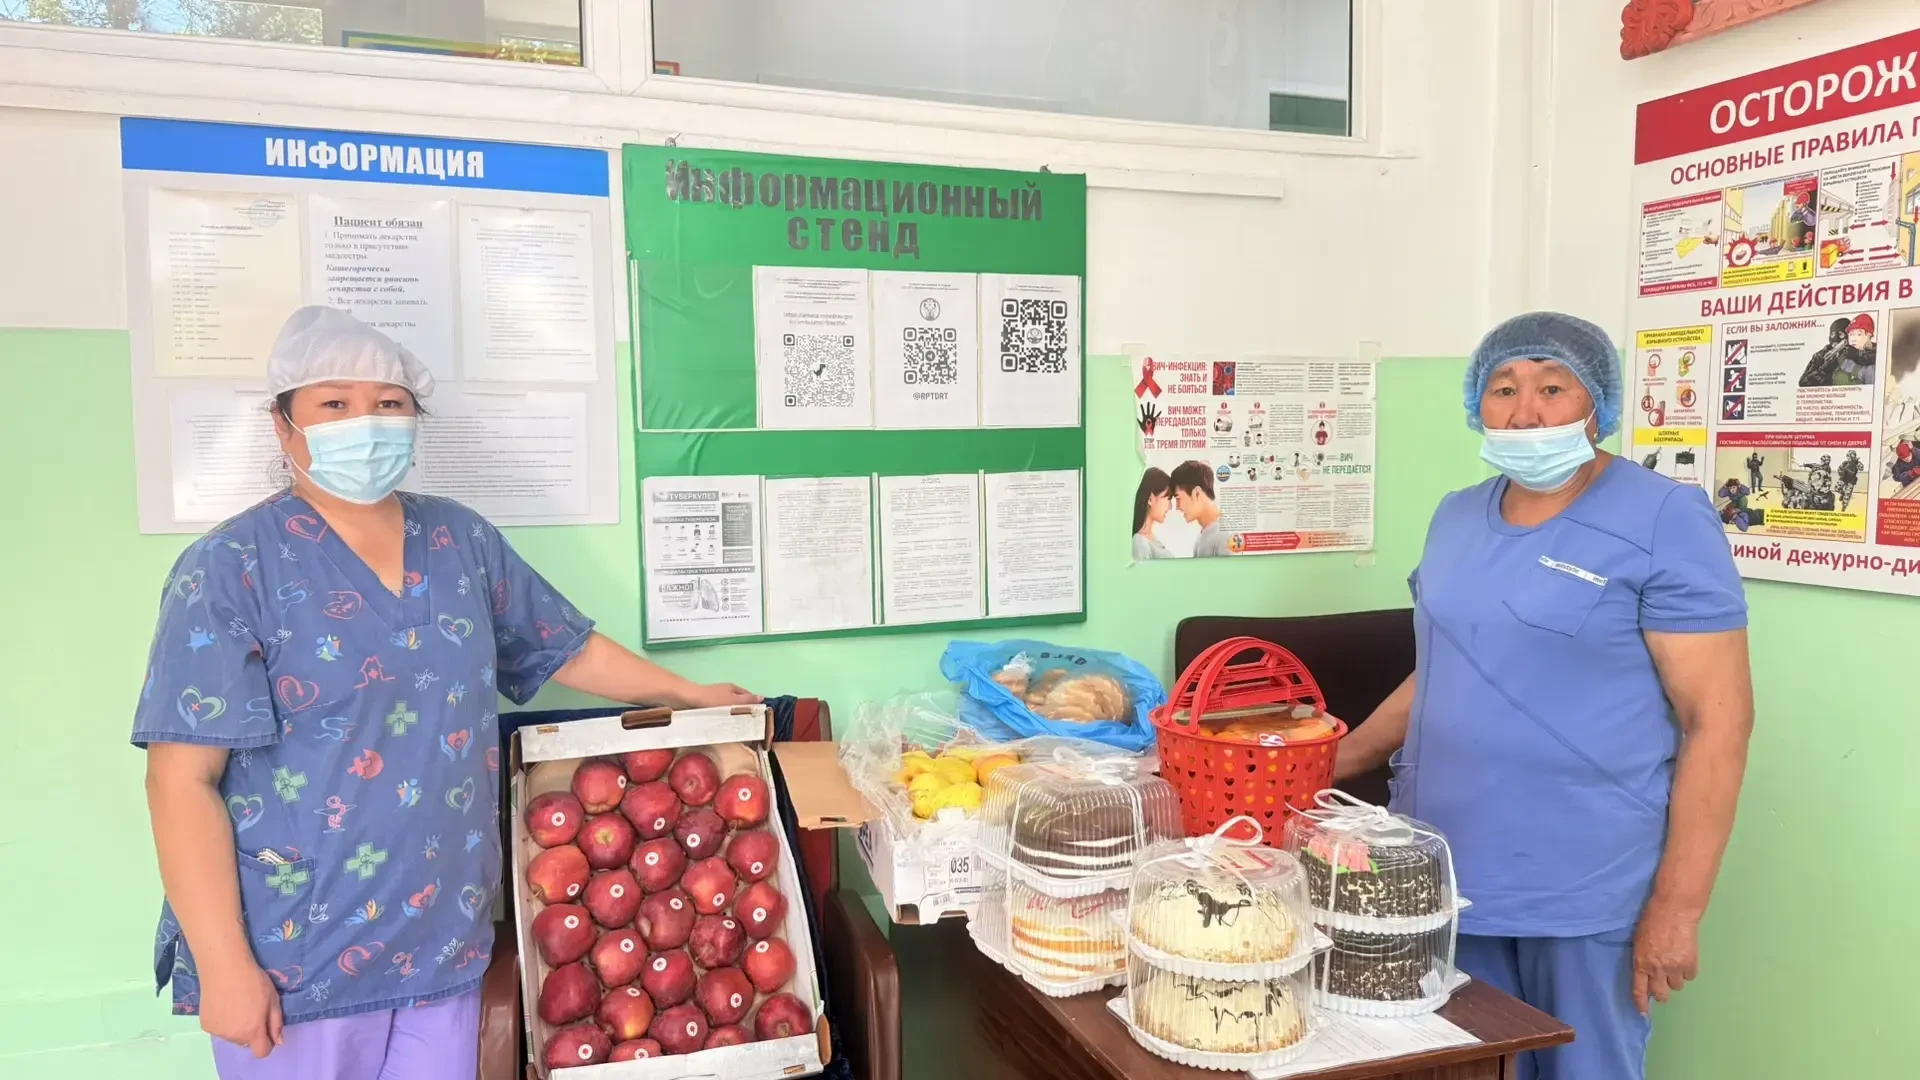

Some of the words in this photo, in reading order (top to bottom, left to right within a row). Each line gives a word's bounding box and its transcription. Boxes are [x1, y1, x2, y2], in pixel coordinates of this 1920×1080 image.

[1709, 51, 1919, 135] ОСТОРОЖ
[1670, 145, 1785, 186] ОСНОВНЫЕ
[1792, 120, 1904, 162] ПРАВИЛА
[265, 137, 484, 181] ИНФОРМАЦИЯ
[333, 215, 383, 228] Пациент
[384, 217, 424, 229] обязан
[333, 232, 377, 241] Принимать
[379, 234, 418, 242] лекарства
[1701, 294, 1762, 317] ВАШИ
[1767, 280, 1890, 316] ДЕЙСТВИЯ
[1898, 278, 1914, 299] В
[1726, 325, 1748, 335] ЕСЛИ
[1750, 324, 1763, 333] ВЫ
[1765, 319, 1826, 332] ЗАЛОЖНИК...
[1152, 361, 1208, 372] ВИЧ-ИНФЕКЦИЯ:
[1180, 373, 1201, 383] ЗНАТЬ
[1202, 373, 1208, 383] И
[1167, 384, 1177, 394] НЕ
[1178, 385, 1207, 394] БОЯТЬСЯ
[912, 391, 949, 401] @RPTDRT
[1167, 405, 1181, 415] ВИЧ
[1182, 405, 1207, 415] МОЖЕТ
[1156, 417, 1207, 427] ПЕРЕДАВАТЬСЯ
[1181, 428, 1207, 438] ТОЛЬКО
[1157, 439, 1178, 449] ТРЕМЯ
[1179, 439, 1207, 449] ПУТЯМИ
[1339, 452, 1353, 462] ВИЧ
[1322, 465, 1331, 474] НЕ
[1331, 464, 1371, 474] ПЕРЕДАЁТСЯ
[669, 492, 717, 501] ТУБЕРКУЛЕЗ
[1729, 542, 1782, 561] иной
[950, 856, 970, 874] 035
